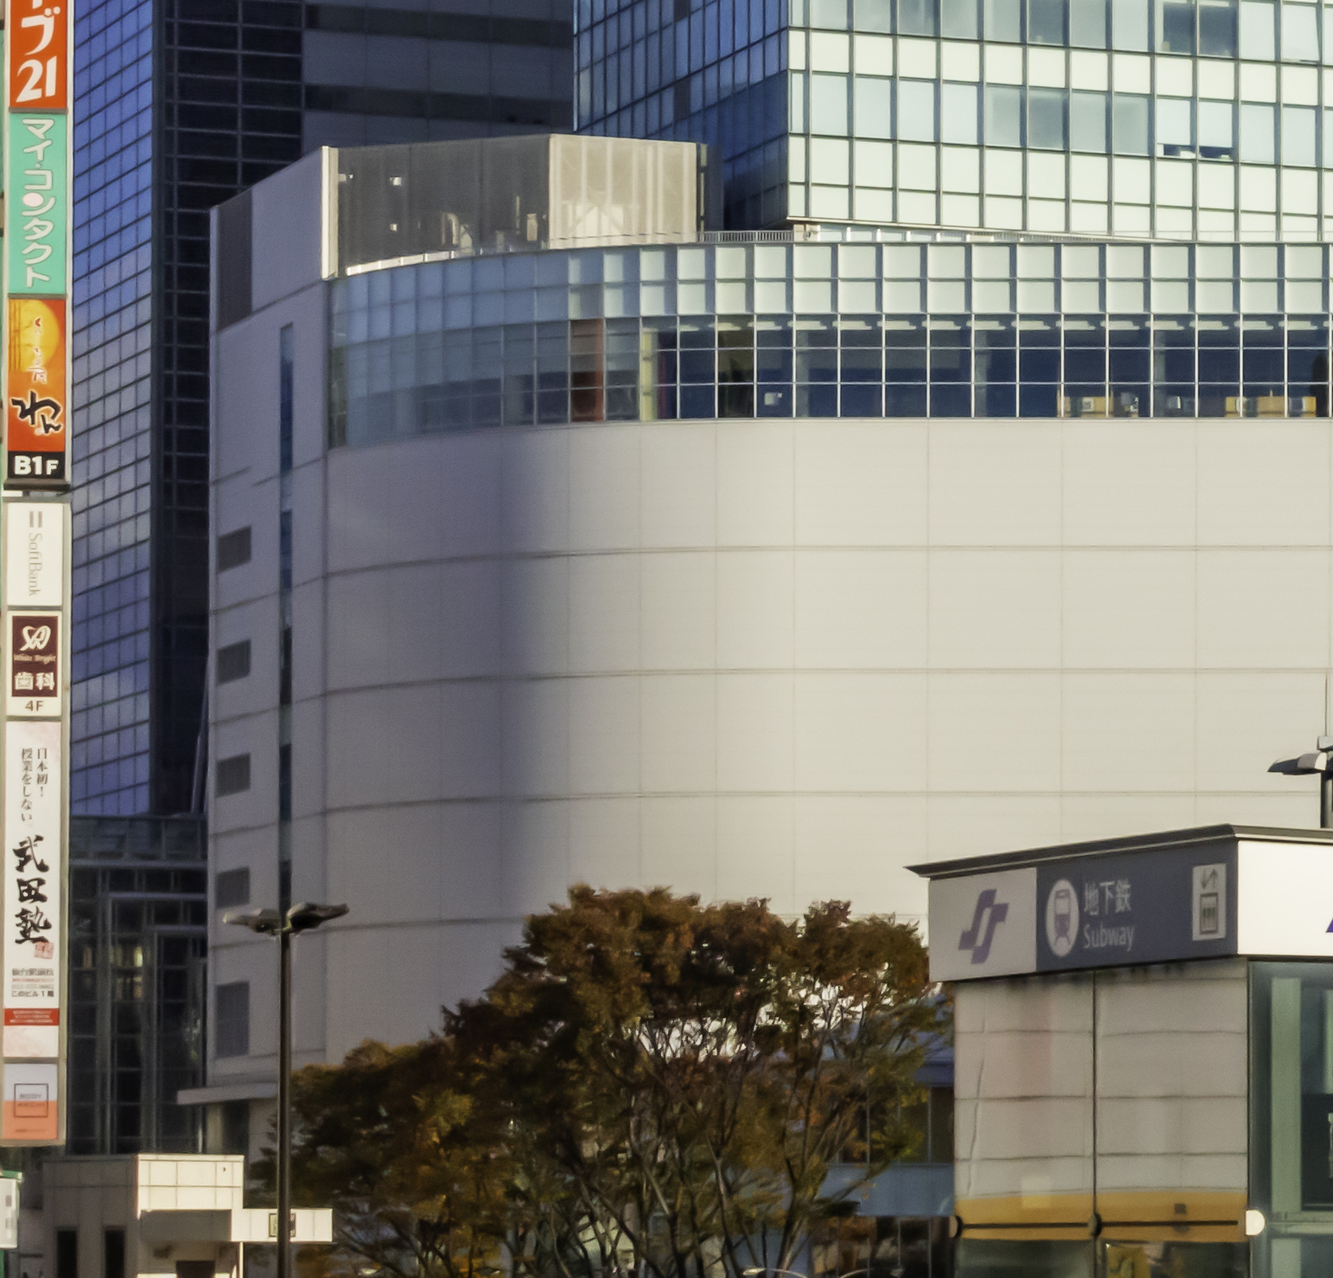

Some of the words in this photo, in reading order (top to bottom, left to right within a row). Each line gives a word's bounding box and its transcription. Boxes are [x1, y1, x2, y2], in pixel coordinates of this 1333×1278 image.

[14, 455, 59, 475] B1F
[28, 532, 43, 597] SoftBank
[14, 671, 55, 691] 歯科
[25, 700, 44, 712] 4F
[12, 835, 52, 945] 武田塾
[1083, 877, 1131, 915] 地下鉄
[1083, 921, 1135, 953] Subway
